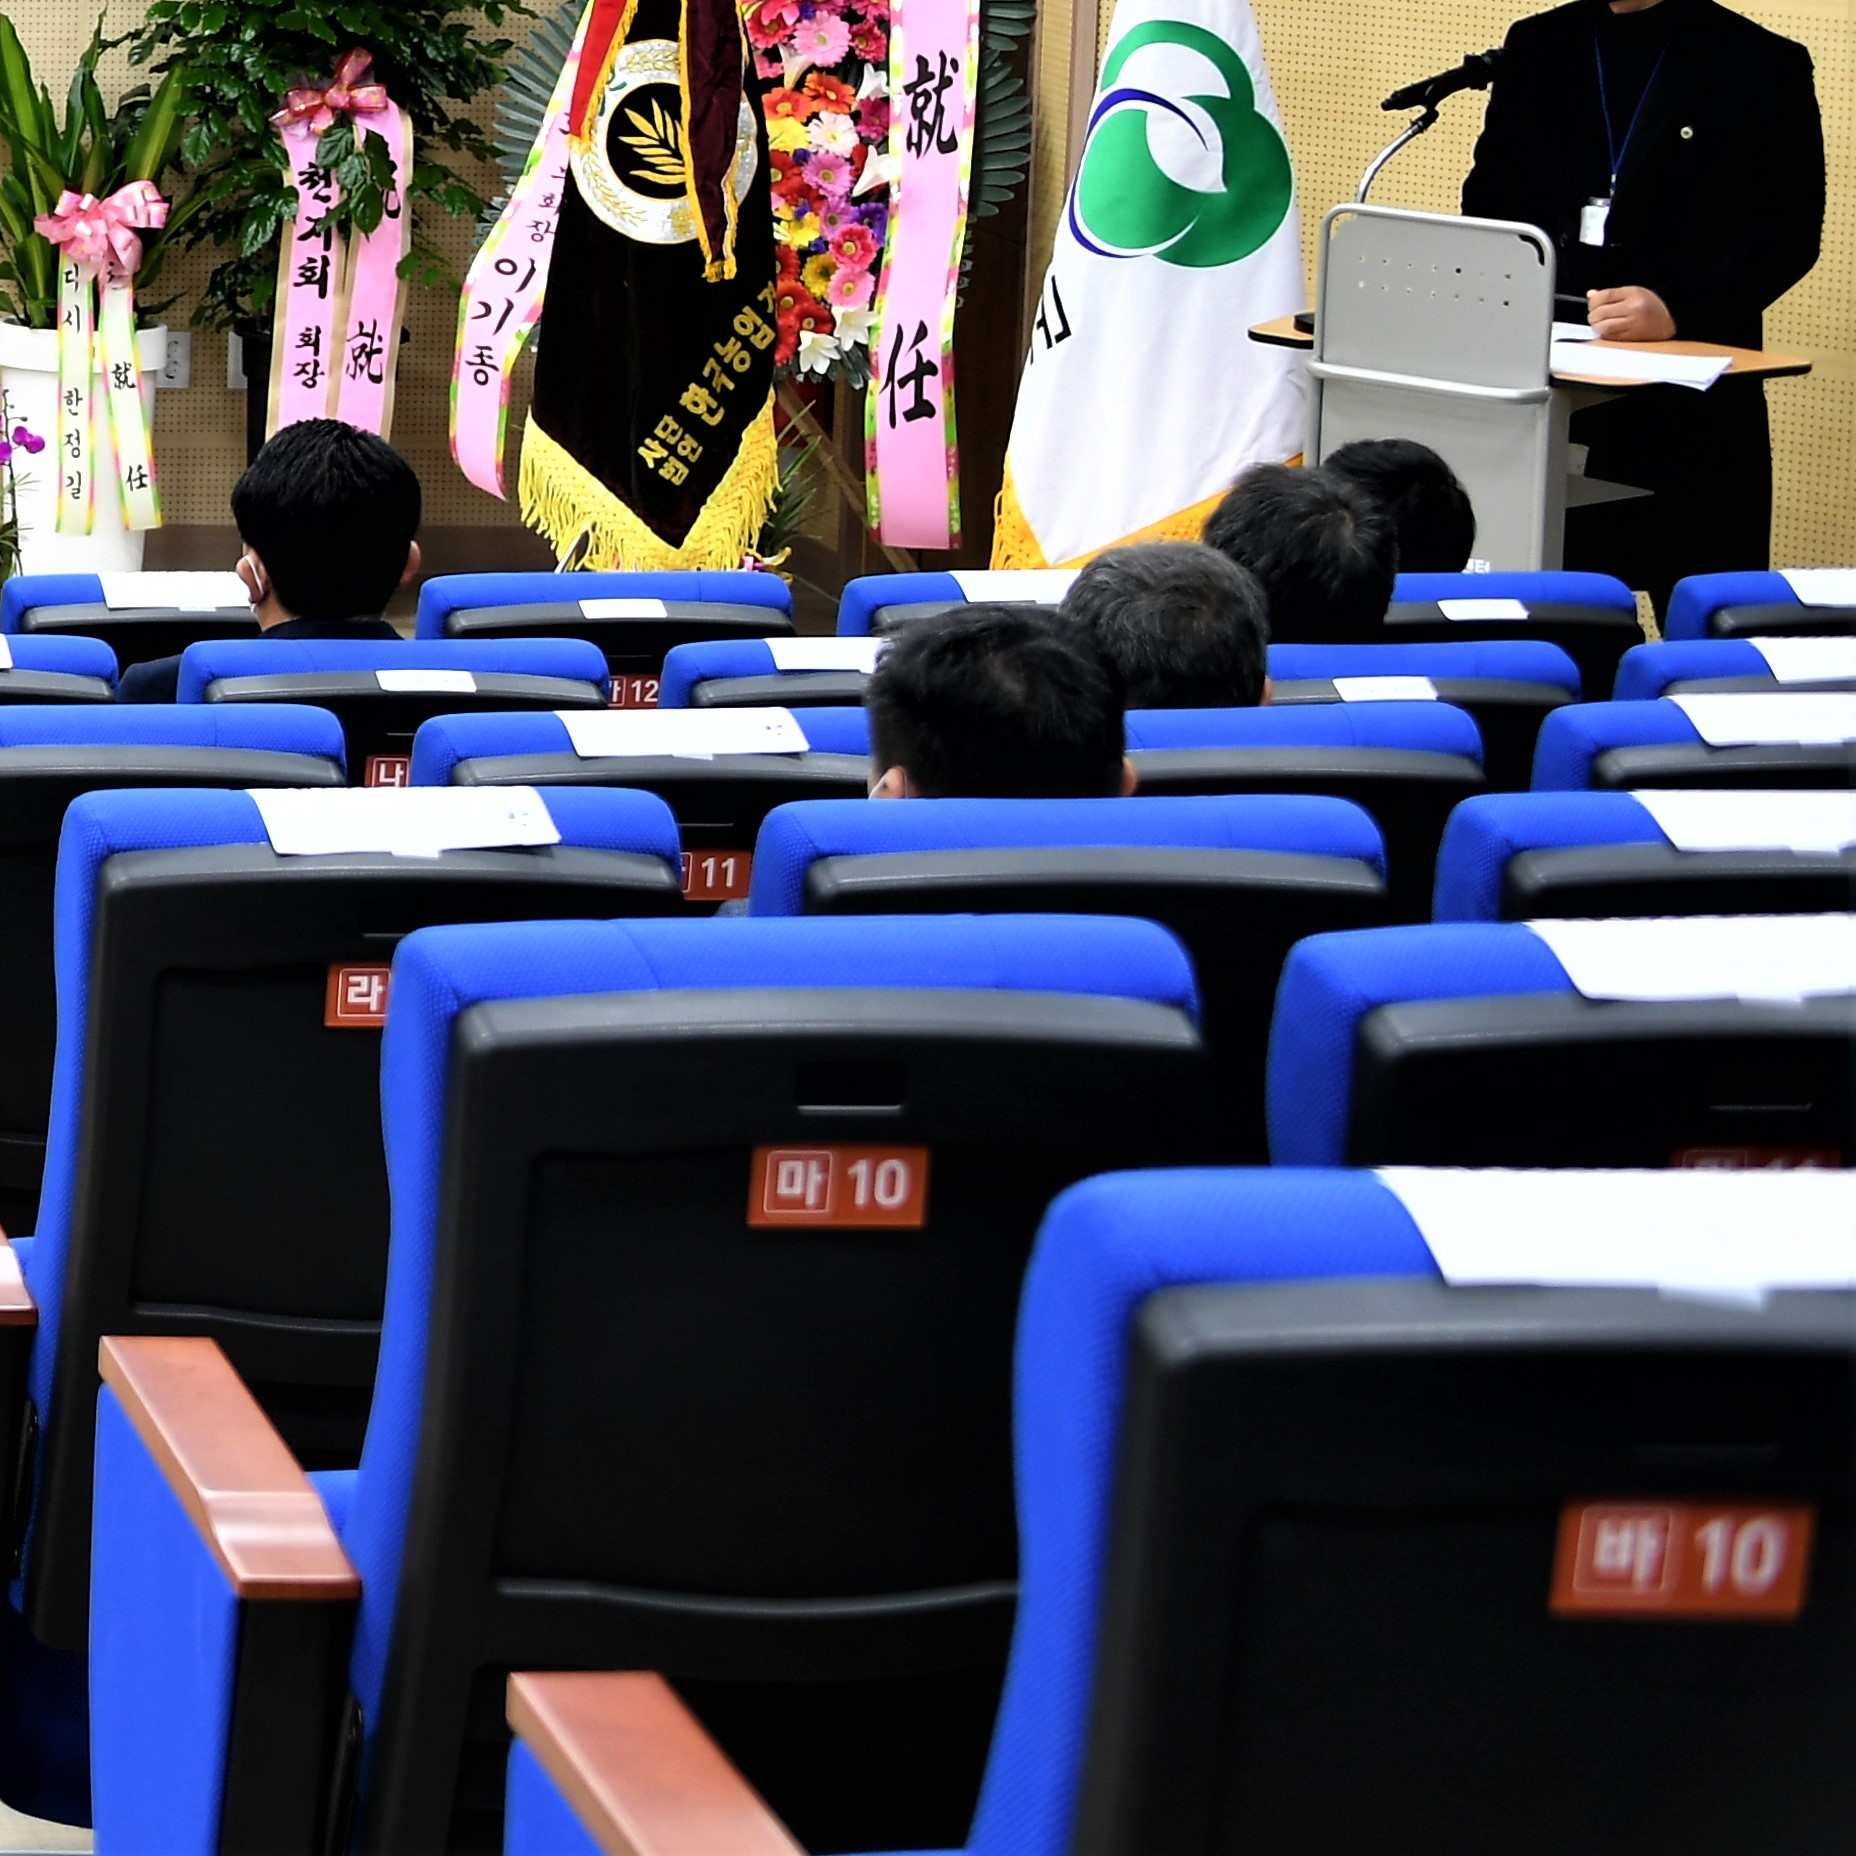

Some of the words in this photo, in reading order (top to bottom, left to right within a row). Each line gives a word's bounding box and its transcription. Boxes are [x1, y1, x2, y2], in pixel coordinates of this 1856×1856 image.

[293, 325, 325, 389] 회장
[631, 679, 659, 703] 12
[701, 857, 735, 888] 11
[347, 975, 384, 1012] 라
[776, 1159, 825, 1208] 마
[846, 1158, 908, 1209] 10
[1694, 1515, 1788, 1597] 10
